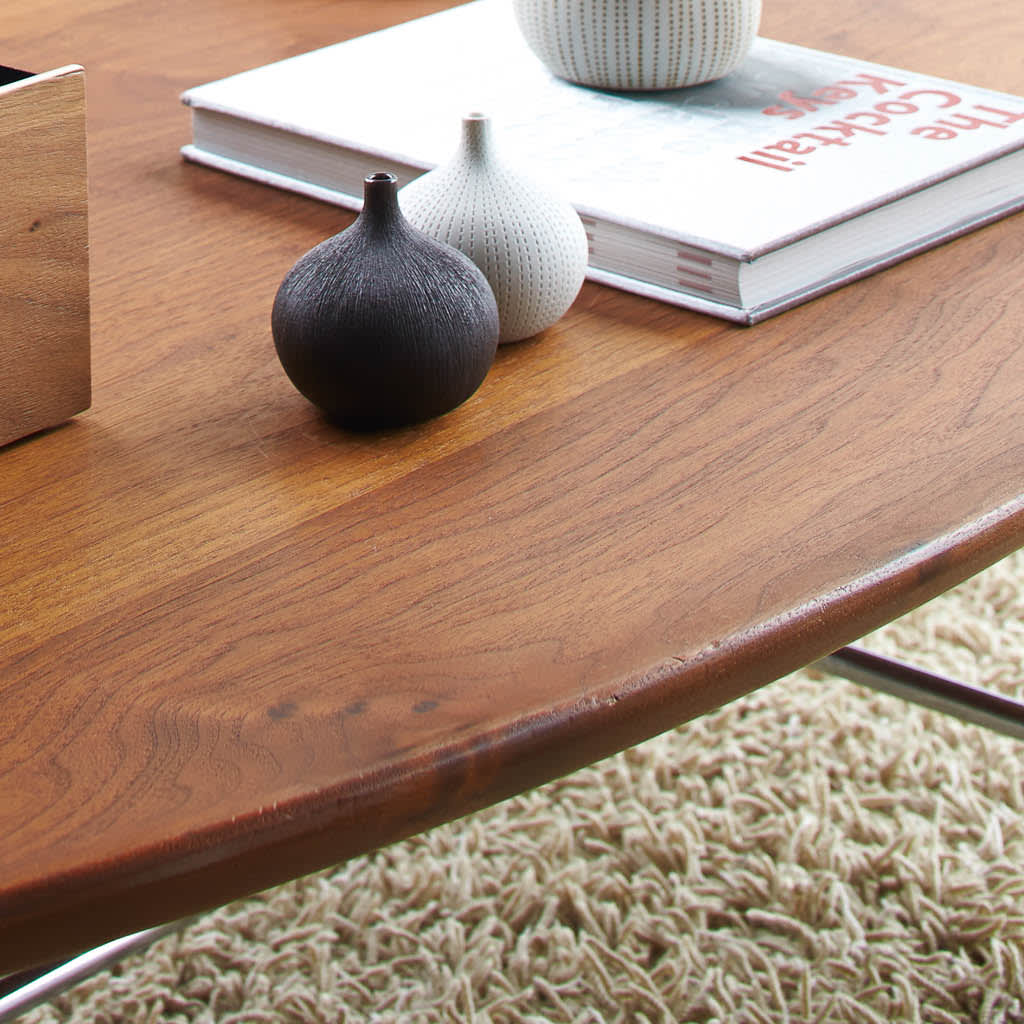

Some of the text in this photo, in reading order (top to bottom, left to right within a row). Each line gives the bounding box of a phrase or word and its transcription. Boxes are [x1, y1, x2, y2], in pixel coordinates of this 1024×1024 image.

[761, 74, 907, 120] Keys
[736, 90, 963, 172] Cocktail
[909, 104, 1024, 141] The
